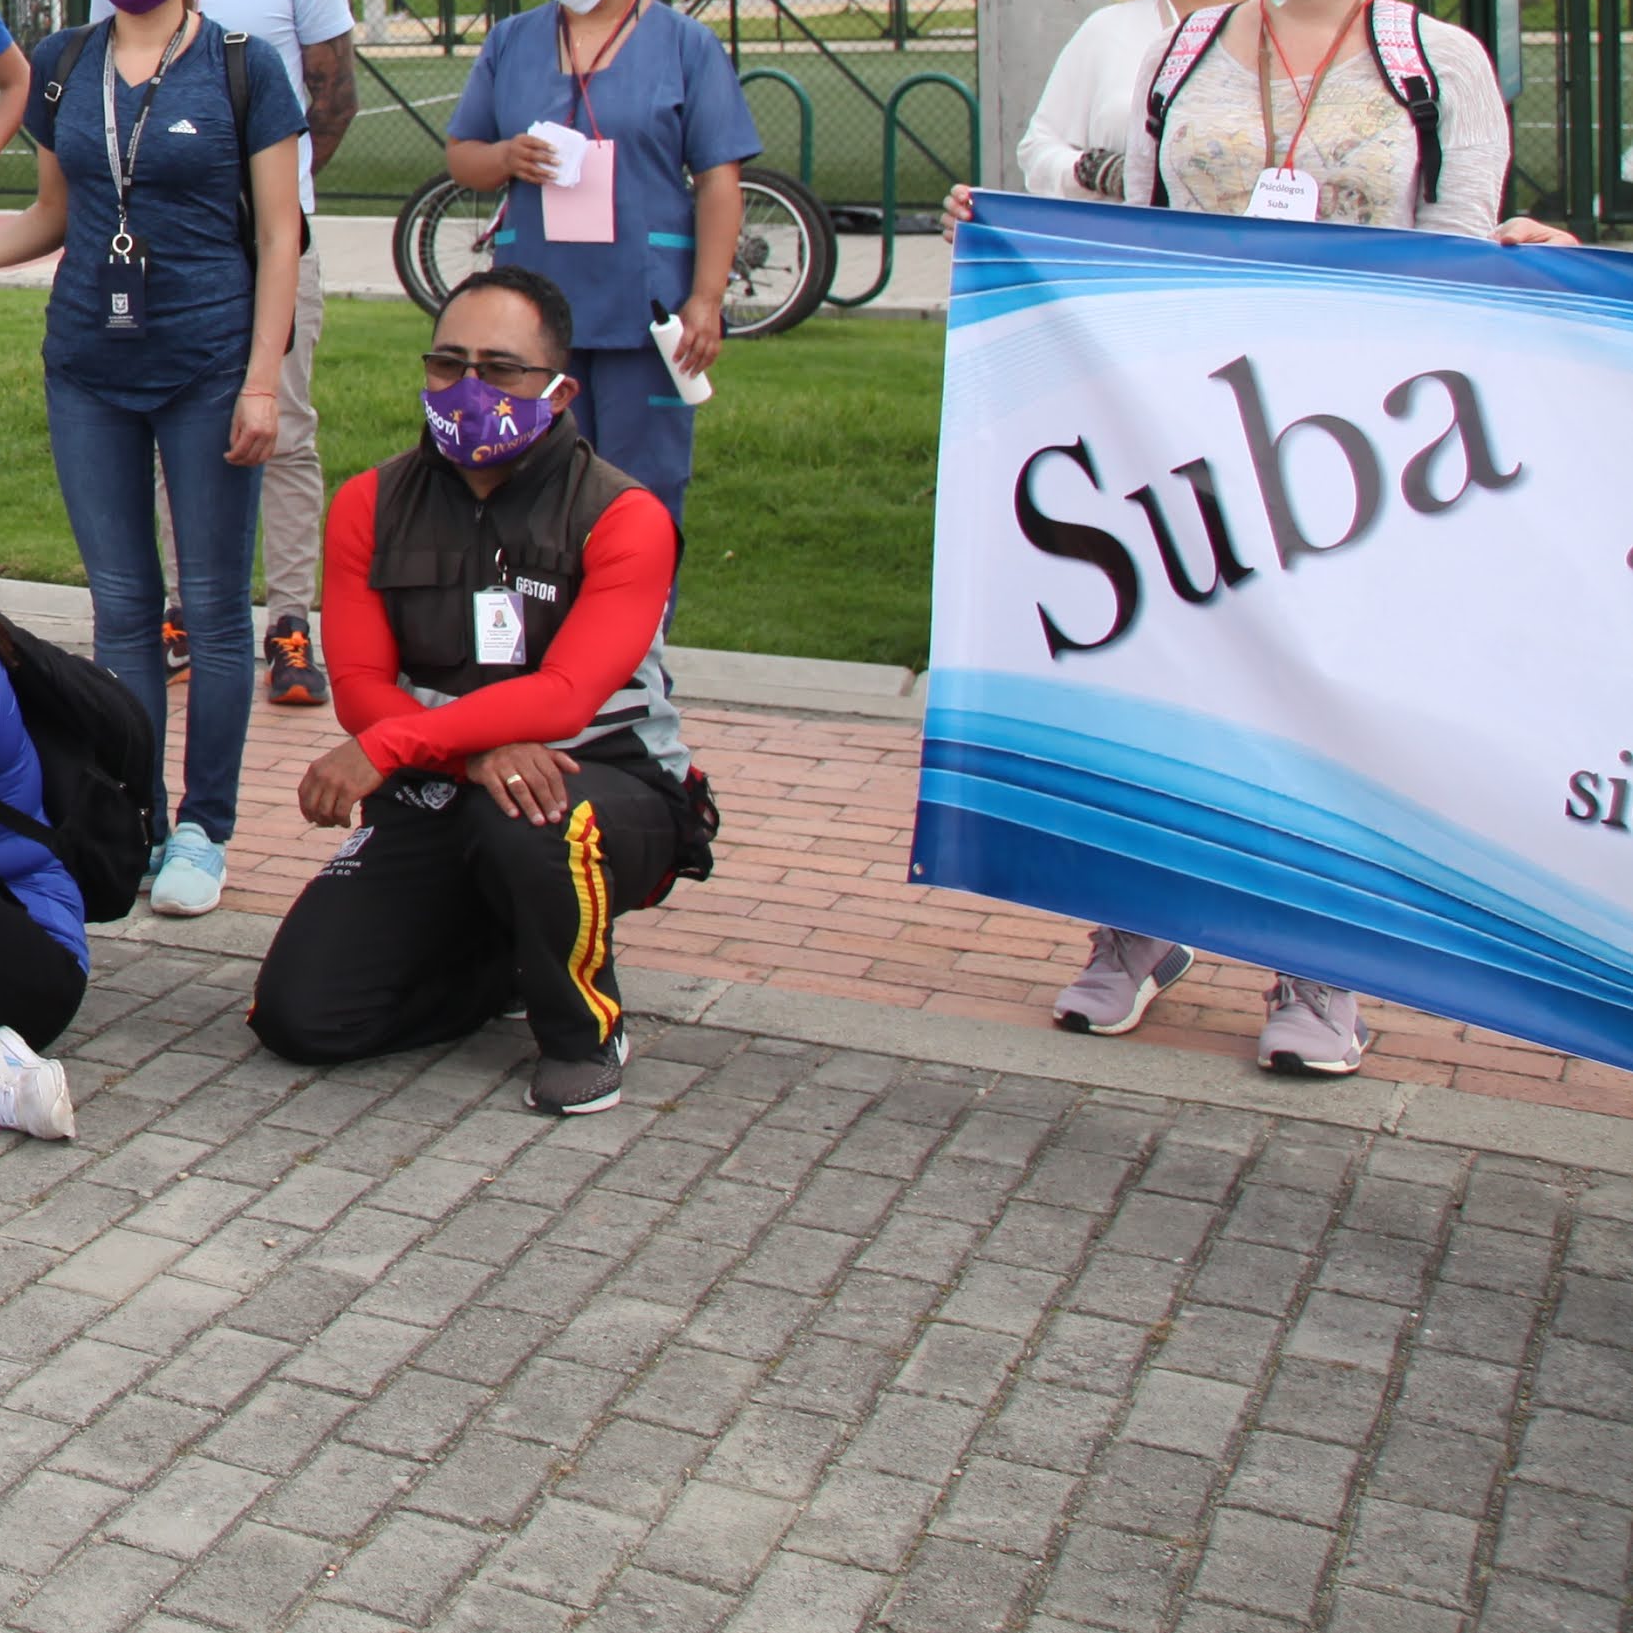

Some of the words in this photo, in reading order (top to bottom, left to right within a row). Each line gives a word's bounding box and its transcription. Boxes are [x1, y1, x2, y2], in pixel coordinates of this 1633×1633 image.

[1267, 199, 1289, 209] Suba
[1013, 355, 1523, 660] Suba
[516, 576, 557, 602] GESTOR
